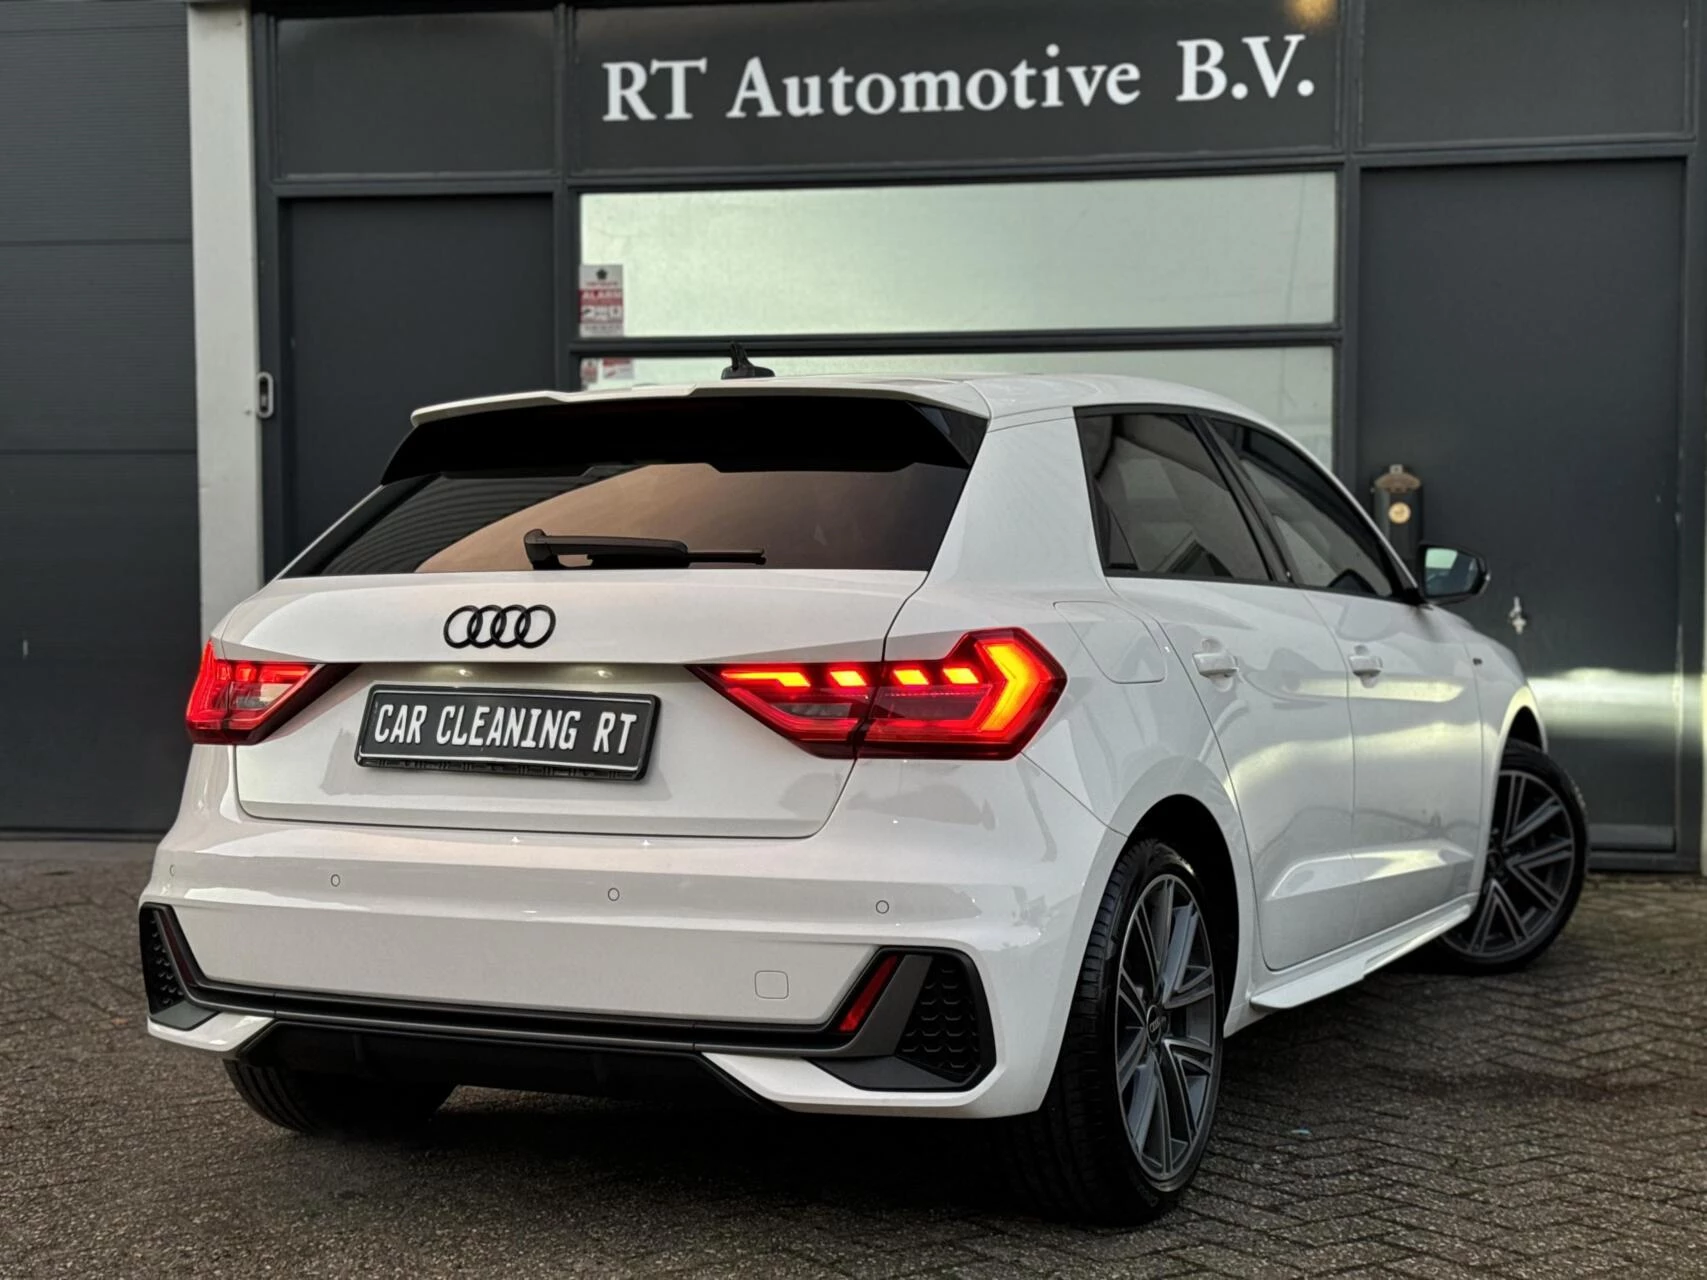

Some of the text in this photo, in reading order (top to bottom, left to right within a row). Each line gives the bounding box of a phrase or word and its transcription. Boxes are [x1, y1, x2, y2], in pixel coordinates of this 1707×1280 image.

[602, 33, 1316, 122] RT Automotive B.V.
[373, 703, 637, 754] CAR CLEANING RT
